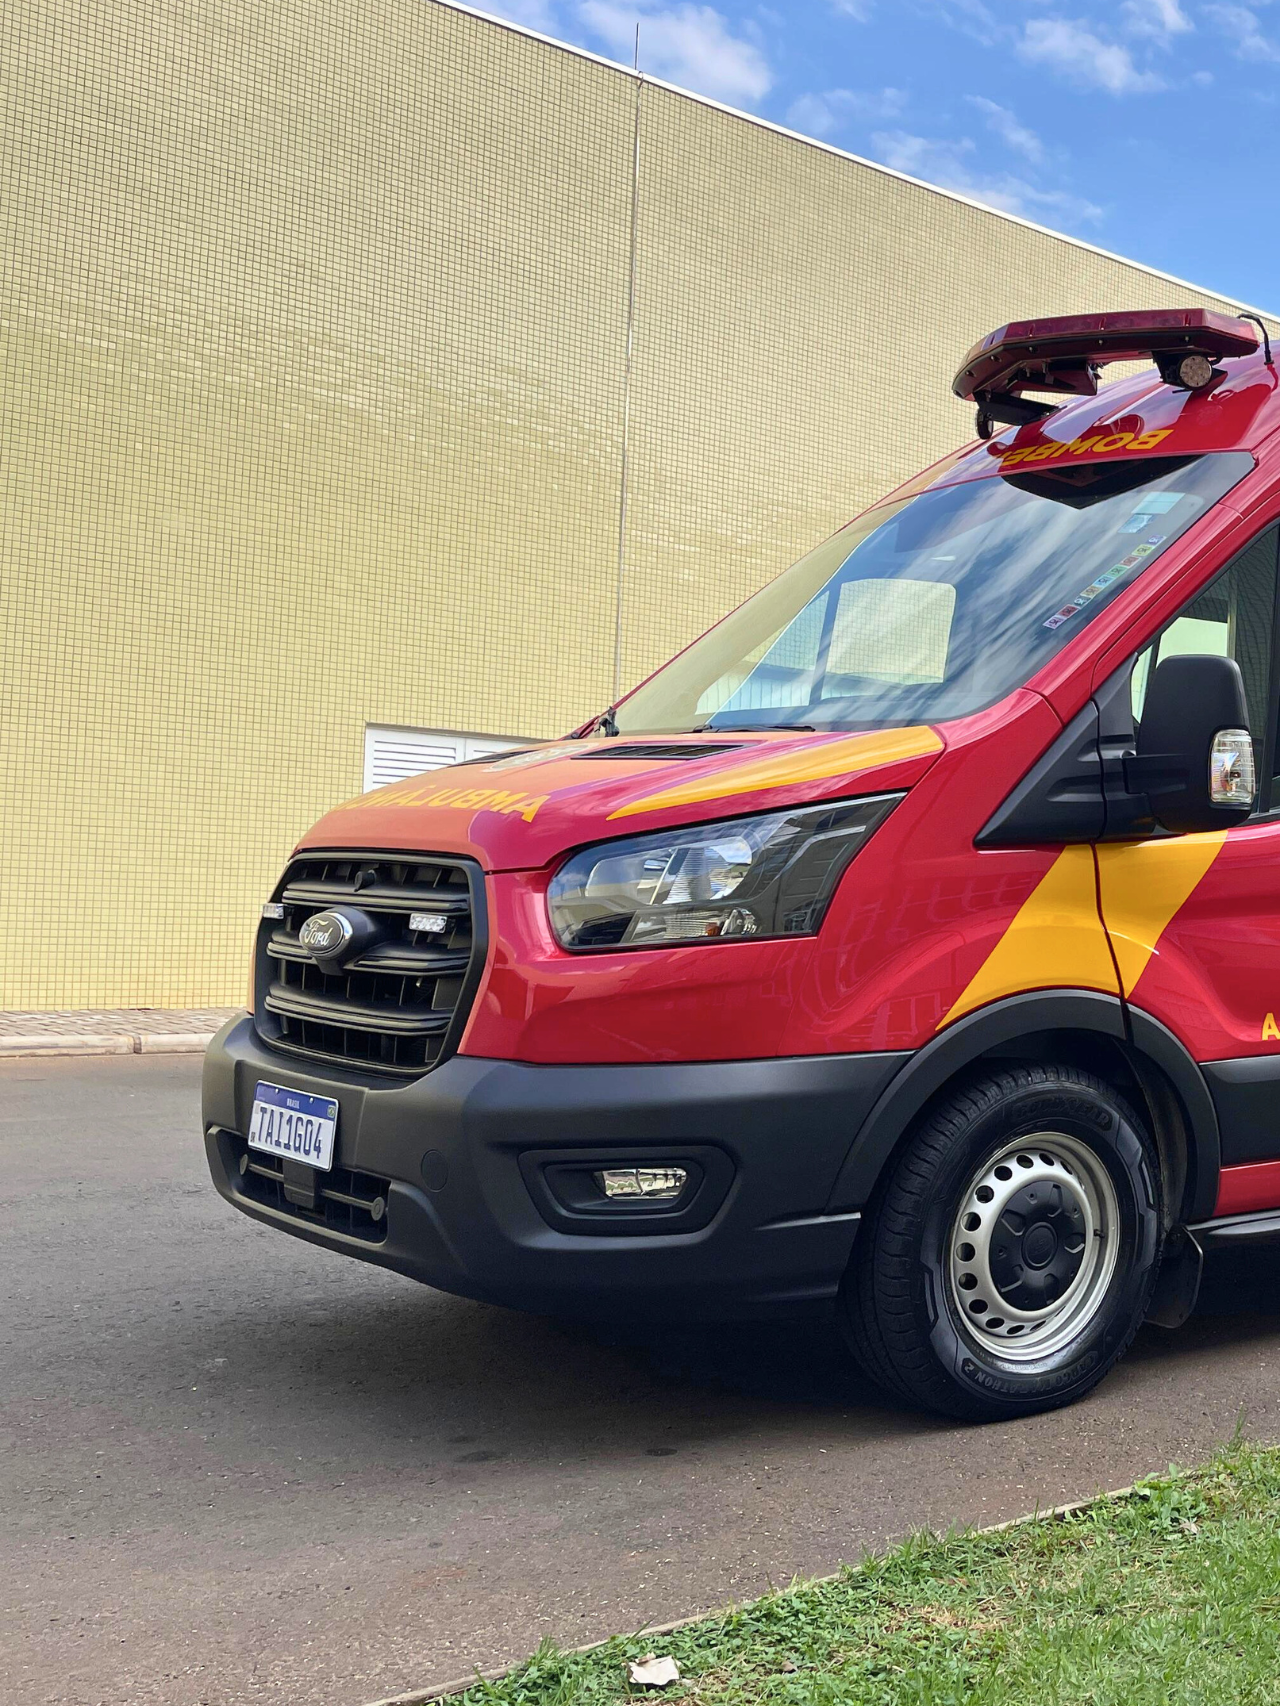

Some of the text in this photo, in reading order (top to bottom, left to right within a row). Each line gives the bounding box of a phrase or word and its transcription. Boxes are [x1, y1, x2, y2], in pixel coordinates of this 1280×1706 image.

[305, 919, 333, 946] Ford
[258, 1106, 322, 1159] TAI1G04
[964, 1362, 975, 1374] 2
